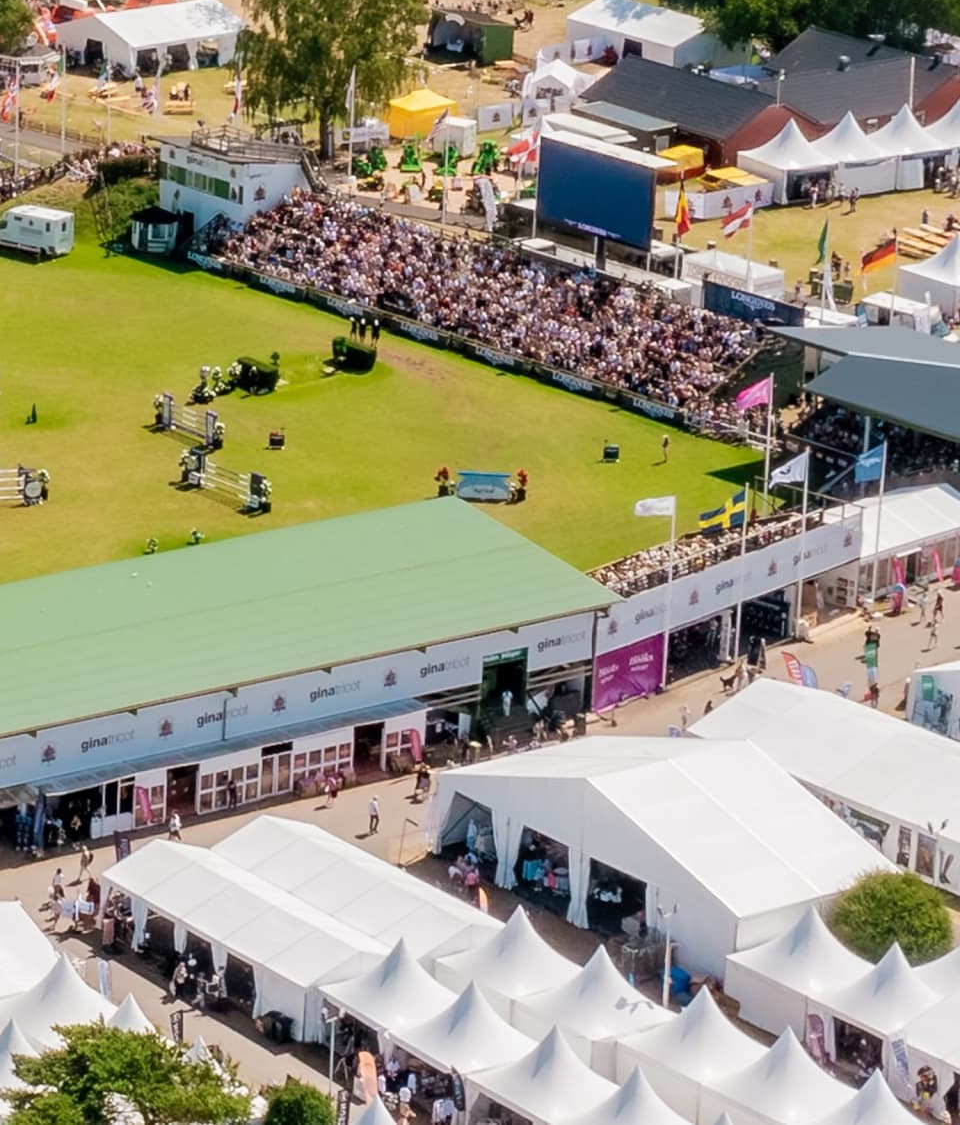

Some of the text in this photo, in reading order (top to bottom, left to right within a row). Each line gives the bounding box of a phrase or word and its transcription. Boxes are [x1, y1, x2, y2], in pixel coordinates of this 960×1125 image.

[731, 290, 776, 311] LONGINES
[537, 630, 586, 652] ginatricot
[419, 656, 470, 678] ginatricot
[309, 679, 361, 703] ginatricot
[196, 704, 249, 728] ginaricot
[81, 729, 135, 752] ginatricot
